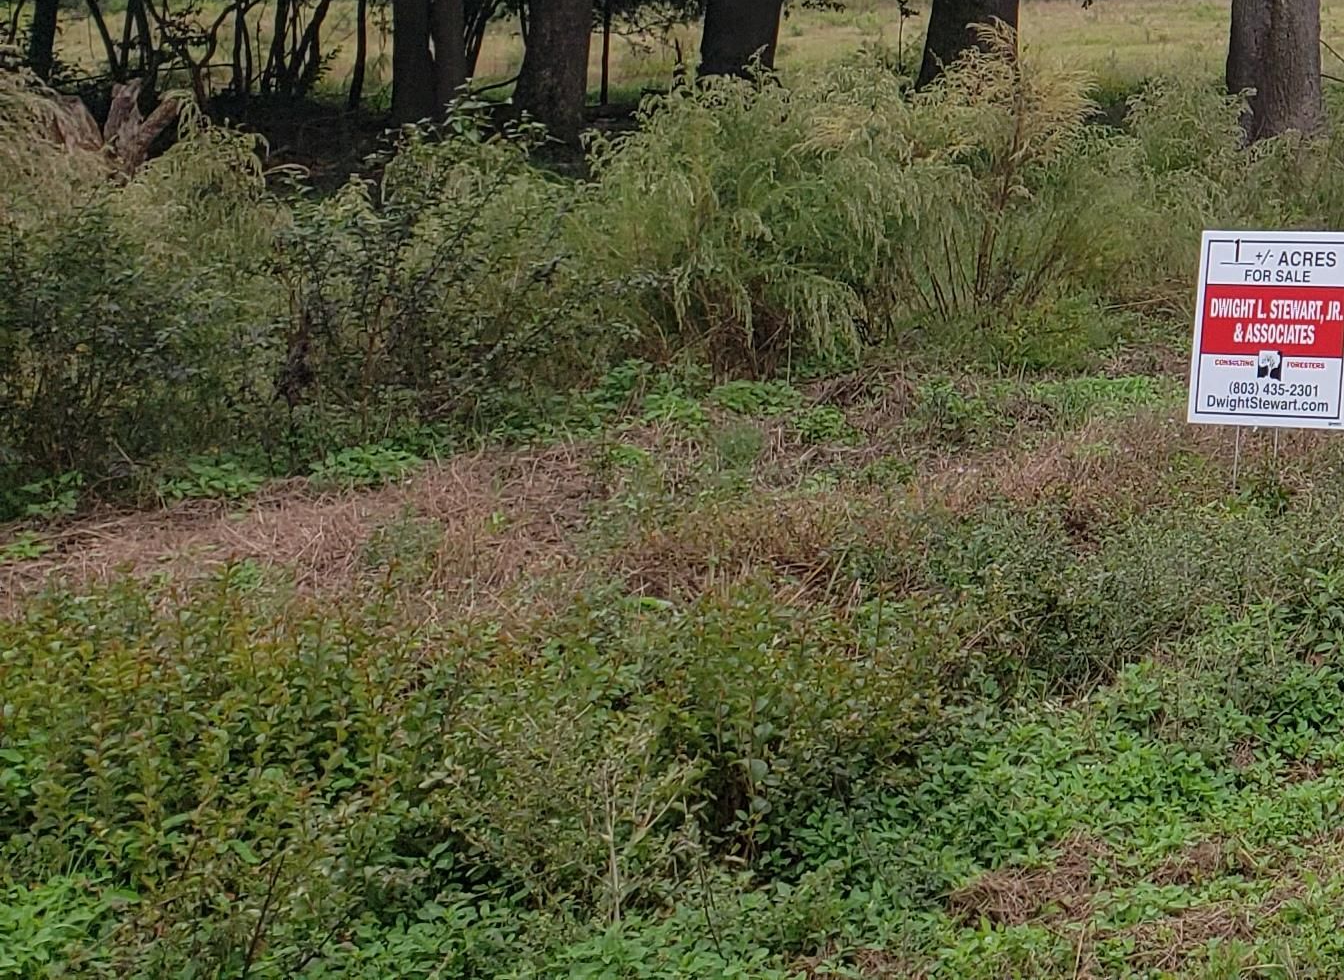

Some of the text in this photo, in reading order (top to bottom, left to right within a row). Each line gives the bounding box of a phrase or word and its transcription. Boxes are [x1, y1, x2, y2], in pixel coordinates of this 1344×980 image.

[1256, 249, 1274, 265] +/-
[1278, 251, 1336, 267] ACRES
[1245, 270, 1311, 282] FOR SALE
[1211, 299, 1343, 324] DWIGHT L. STEWART, JR.
[1233, 323, 1315, 344] & ASSOCIATES
[1215, 359, 1254, 367] CONSULTING
[1229, 382, 1319, 397] (803) 435-2301
[1207, 395, 1328, 412] DwightStewart.com
